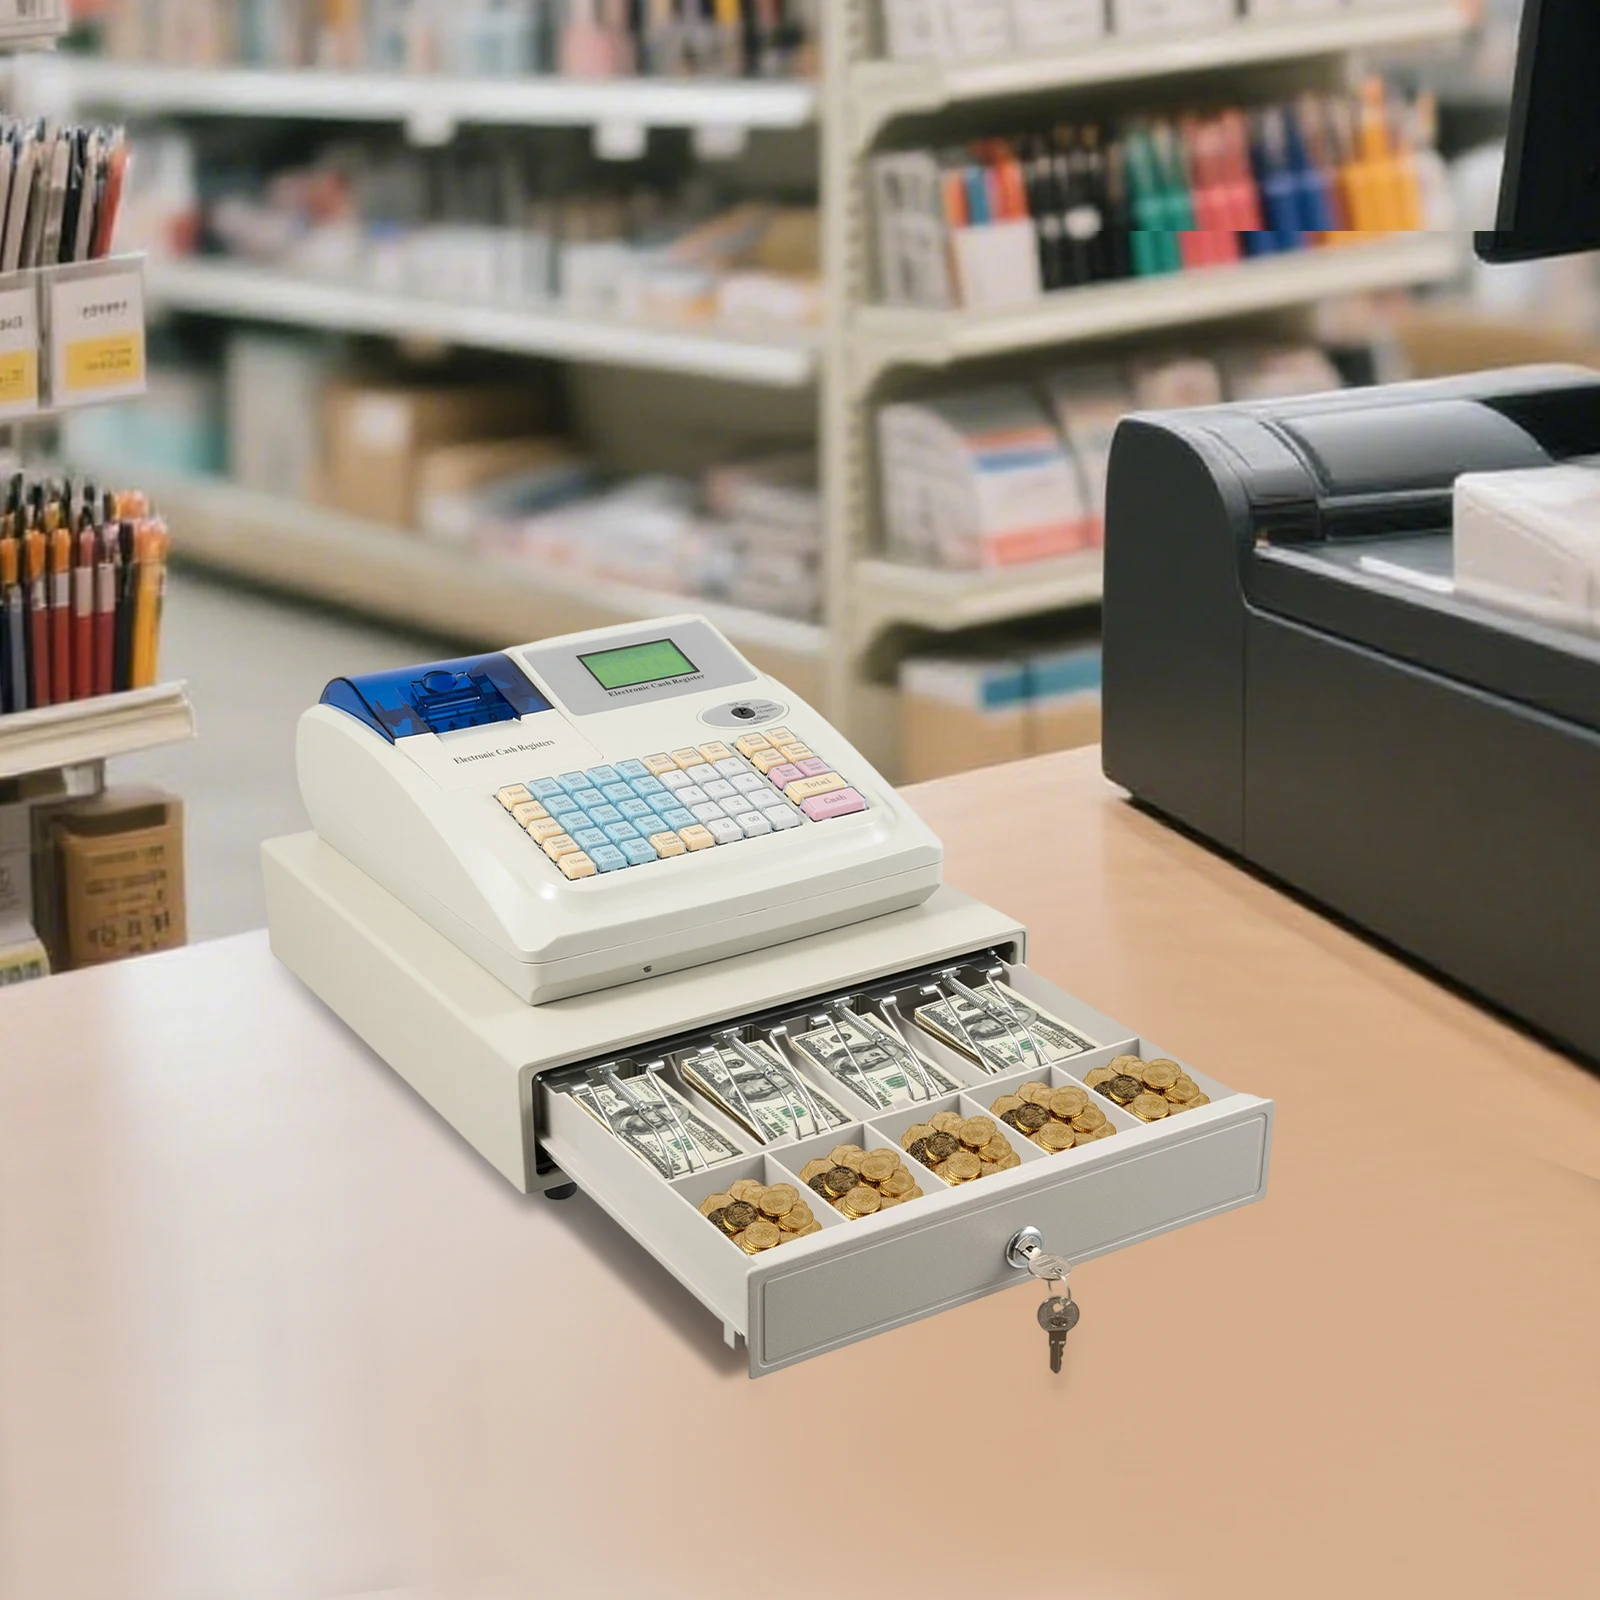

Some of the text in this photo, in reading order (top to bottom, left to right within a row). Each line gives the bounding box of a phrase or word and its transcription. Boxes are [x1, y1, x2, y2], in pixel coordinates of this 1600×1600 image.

[607, 674, 705, 698] Electronic Cash Register
[453, 739, 556, 765] Electronic Cash Registers
[803, 777, 832, 789] Total
[823, 794, 847, 804] Cash
[747, 815, 760, 823] 00
